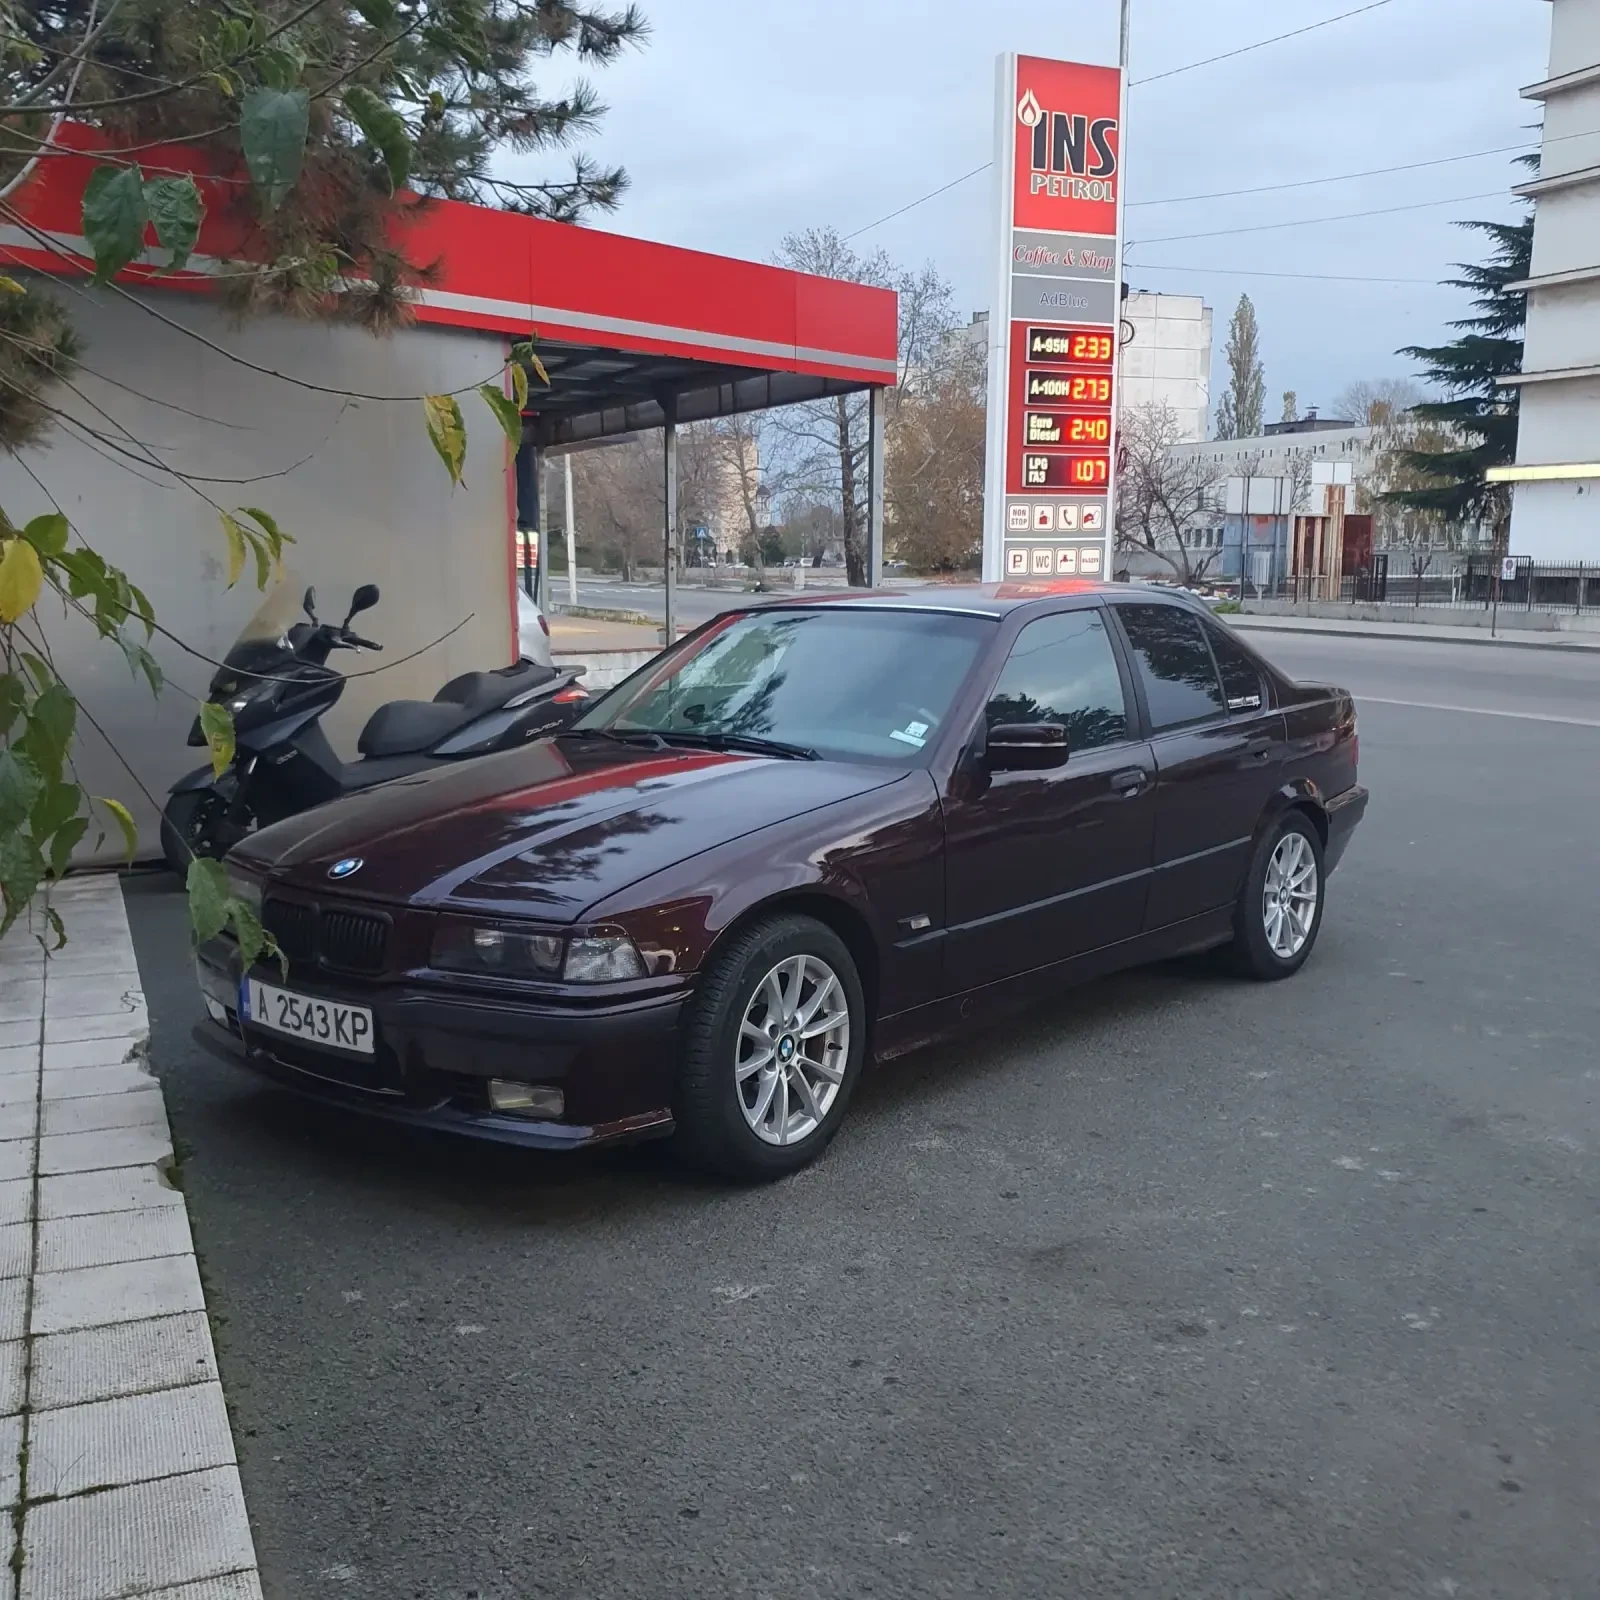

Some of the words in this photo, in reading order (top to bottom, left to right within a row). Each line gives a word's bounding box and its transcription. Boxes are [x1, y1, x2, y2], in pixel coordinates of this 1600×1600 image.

[1031, 110, 1118, 178] INS
[1030, 172, 1115, 203] PETROL
[1013, 244, 1060, 268] Coffee
[1063, 248, 1076, 267] &
[1079, 249, 1114, 273] Shop
[1039, 291, 1089, 308] AdBlue
[1073, 336, 1111, 360] 2.33
[1072, 378, 1110, 401] 2.73
[1070, 418, 1108, 441] 2.40
[1028, 457, 1048, 470] LPG
[1011, 517, 1028, 526] STOP
[1012, 508, 1027, 517] NON
[1012, 554, 1023, 569] P
[1035, 555, 1050, 568] WC
[259, 987, 269, 1022] A
[276, 994, 331, 1039] 2543
[333, 1007, 369, 1046] KP
